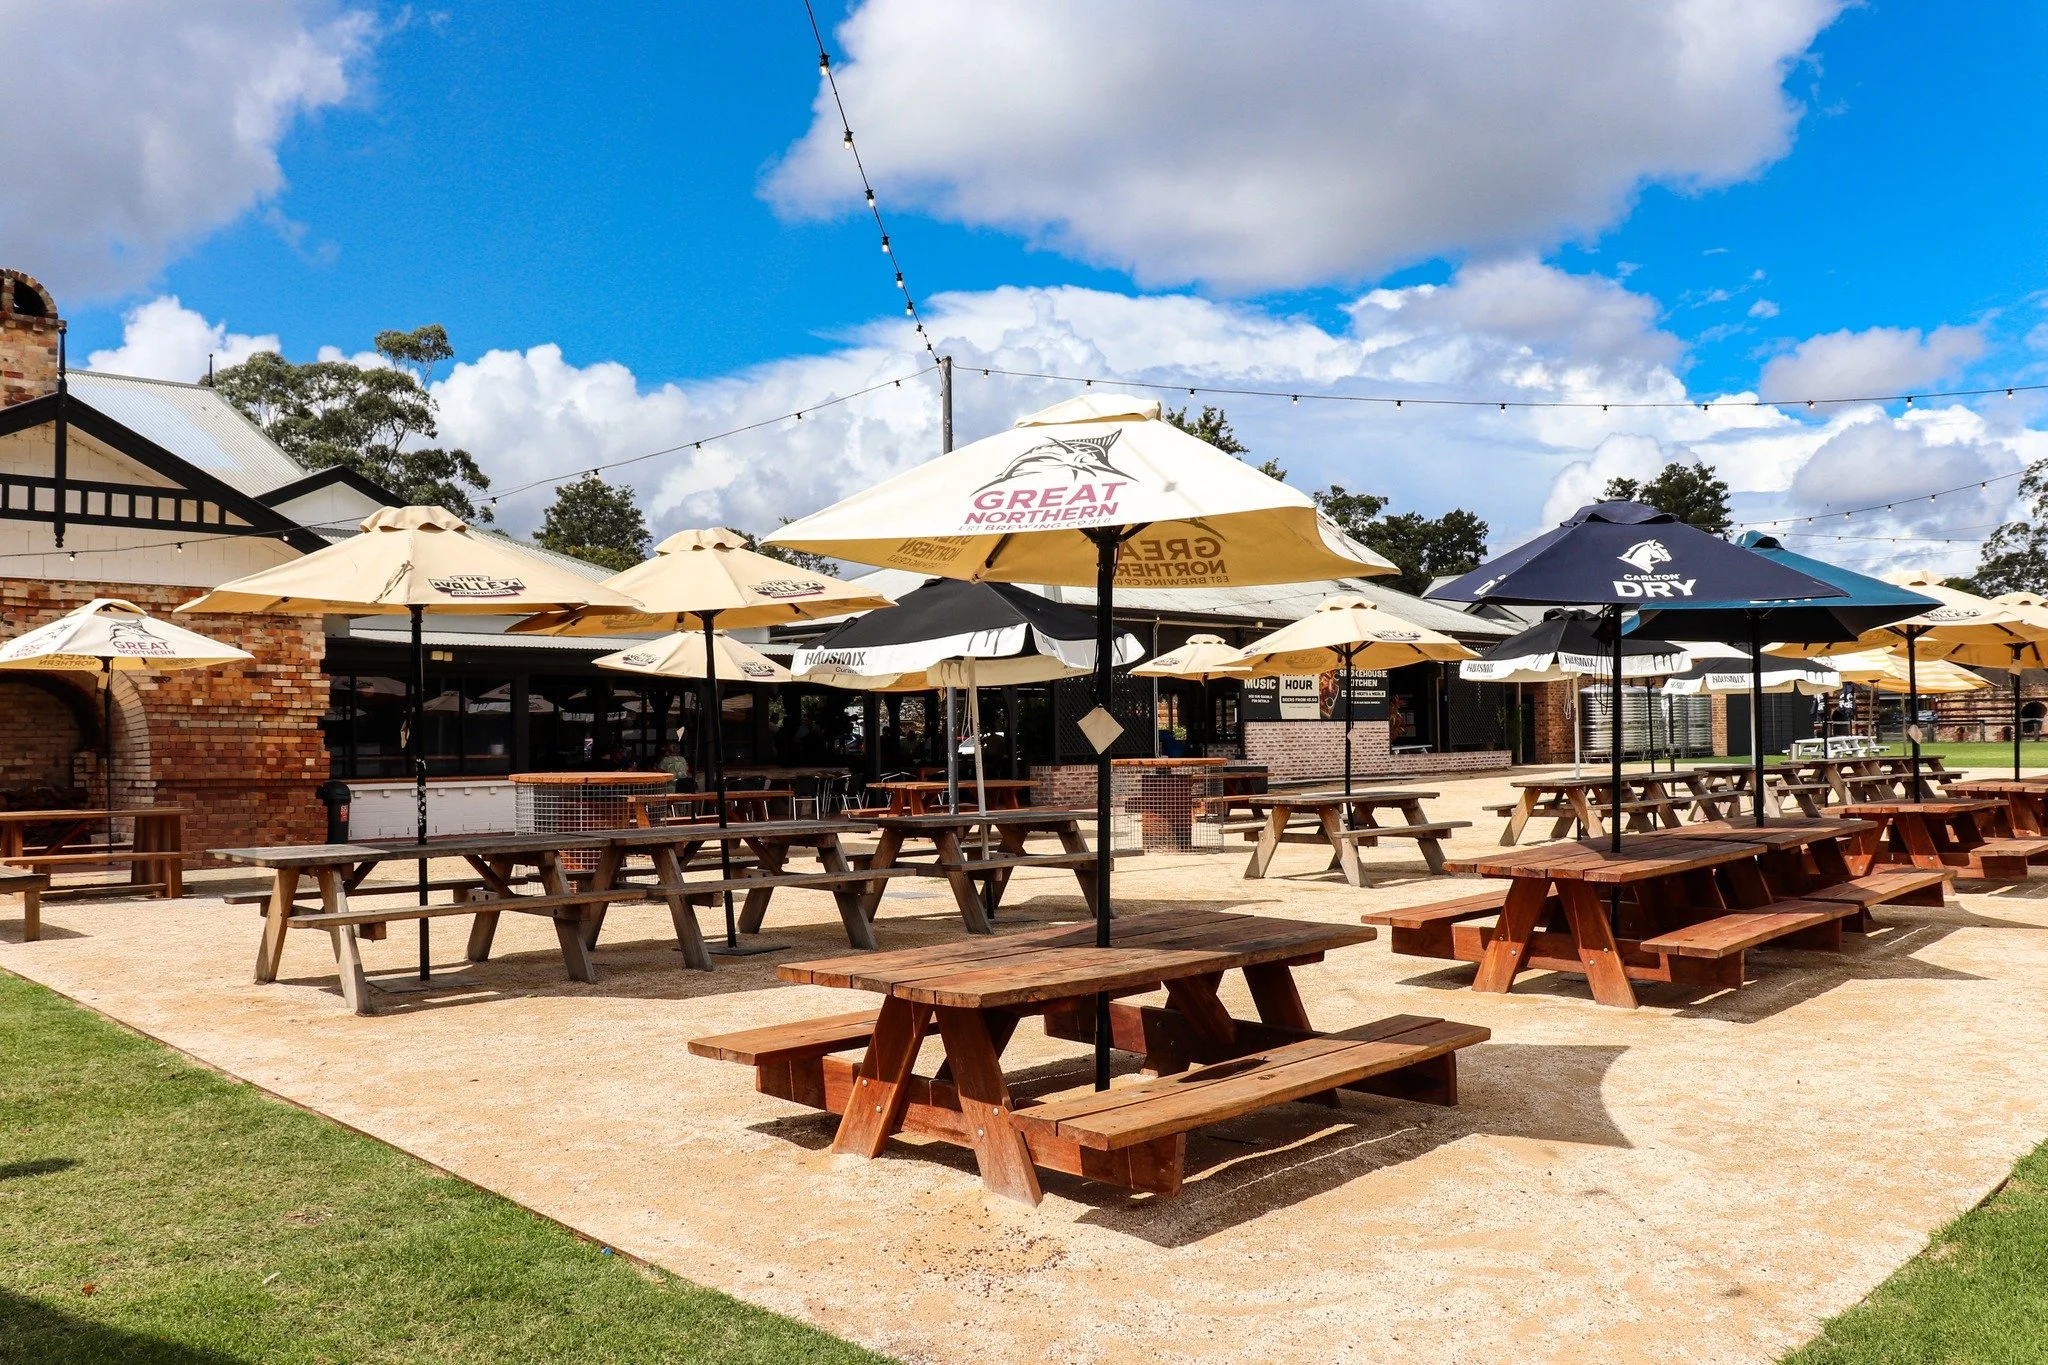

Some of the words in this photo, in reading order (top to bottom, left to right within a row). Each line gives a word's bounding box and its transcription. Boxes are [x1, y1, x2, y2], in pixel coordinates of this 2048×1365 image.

[974, 482, 1127, 510] GREAT
[964, 502, 1118, 524] NORTHERN
[985, 521, 1061, 531] BREWING
[1623, 573, 1680, 581] CARLTON
[440, 580, 510, 591] VALLEY
[1612, 579, 1697, 597] DRY
[113, 641, 169, 650] GREAT
[804, 651, 866, 666] HAUSMIX
[1244, 679, 1276, 689] MUSIC
[1285, 680, 1313, 690] HOUR
